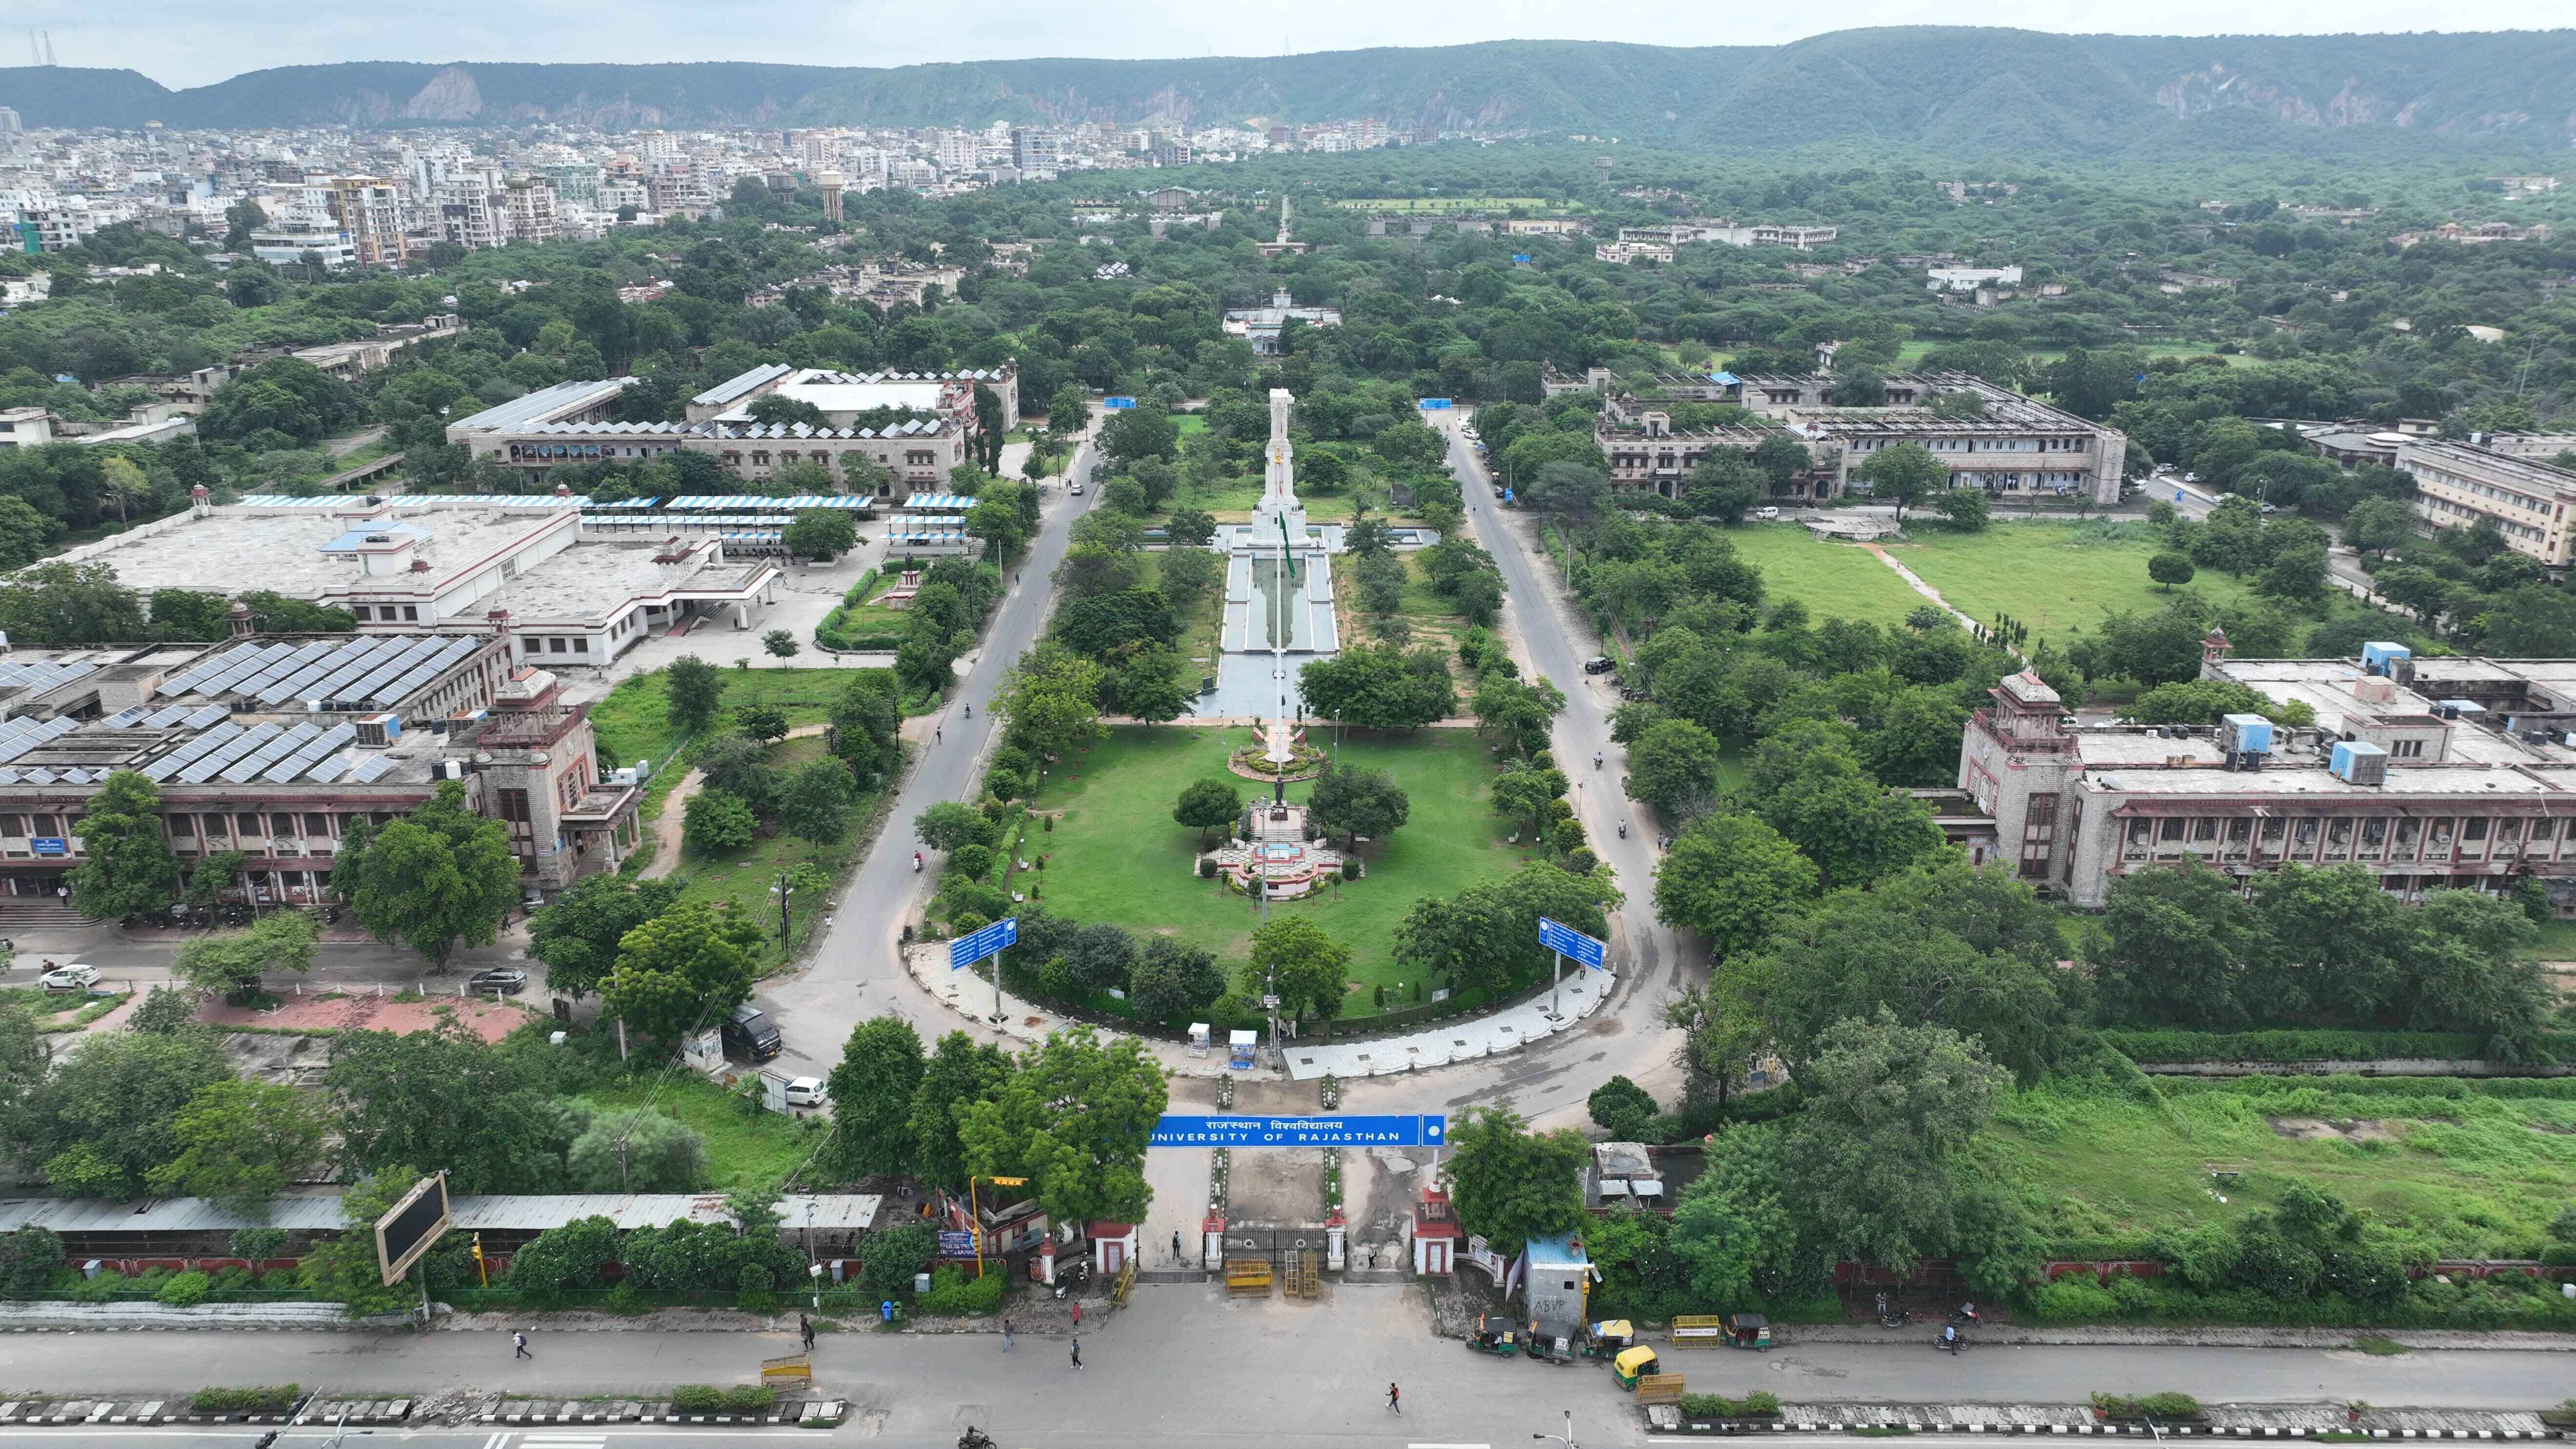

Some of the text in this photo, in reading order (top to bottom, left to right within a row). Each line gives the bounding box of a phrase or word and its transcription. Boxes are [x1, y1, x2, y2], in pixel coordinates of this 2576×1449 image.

[1206, 1120, 1343, 1130] राजस्थान विश्वविद्यालय
[1299, 1132, 1399, 1141] RAJASTHAN
[1533, 1300, 1564, 1312] ABVP
